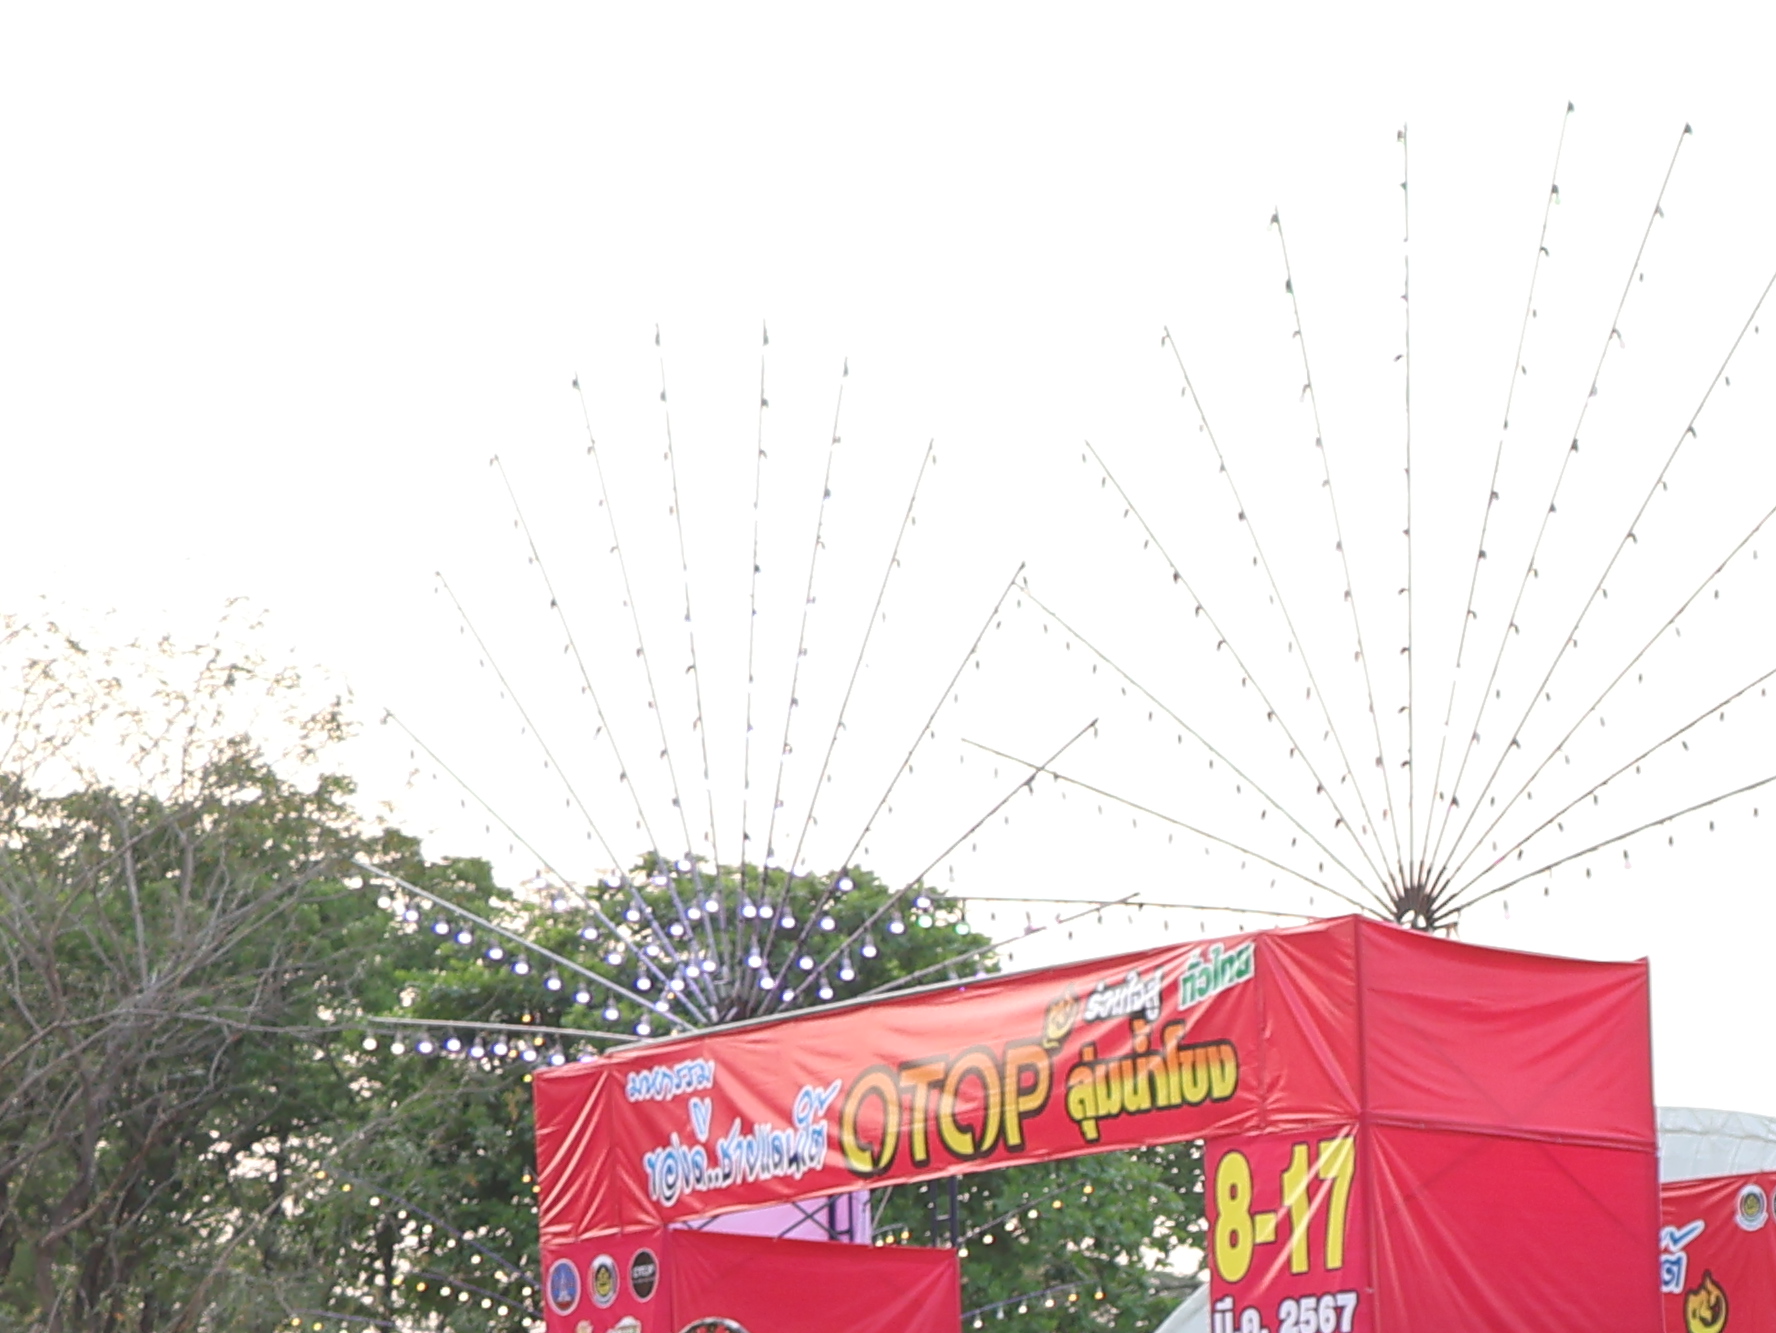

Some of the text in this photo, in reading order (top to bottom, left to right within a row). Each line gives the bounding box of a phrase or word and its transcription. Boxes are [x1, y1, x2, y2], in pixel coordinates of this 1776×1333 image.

[1177, 941, 1256, 1013] ทั่วไทย
[625, 1057, 717, 1103] มหกรรม
[838, 1041, 1056, 1178] OTOP
[1213, 1135, 1357, 1284] 8-17
